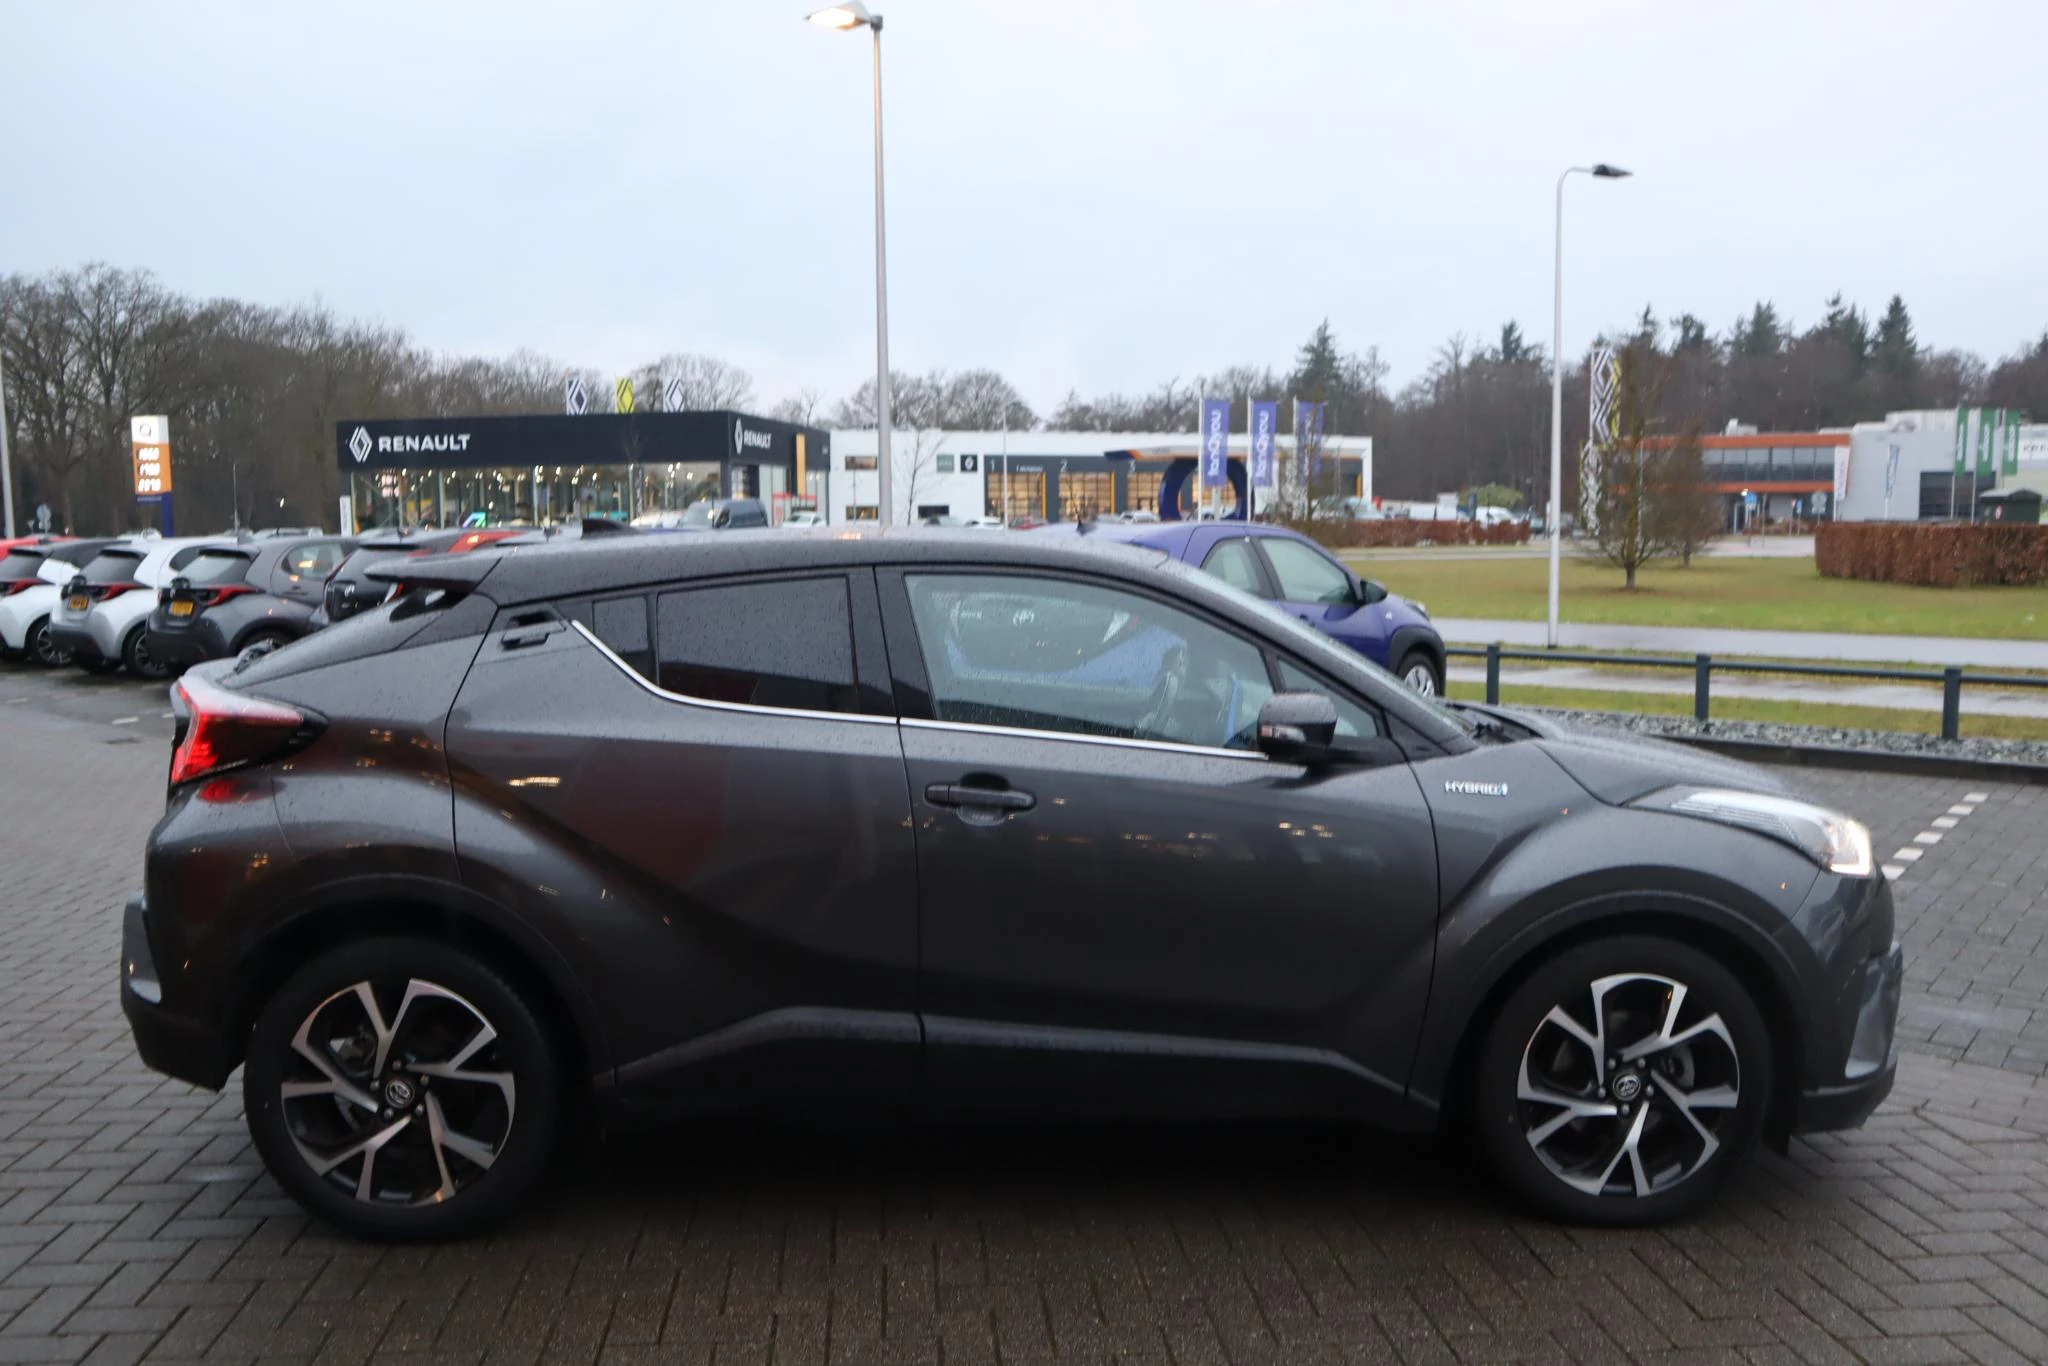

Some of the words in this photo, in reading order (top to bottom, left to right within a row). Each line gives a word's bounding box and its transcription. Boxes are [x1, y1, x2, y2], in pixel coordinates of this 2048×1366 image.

[378, 433, 471, 453] RENAULT
[743, 428, 772, 450] RENAULT
[1059, 458, 1069, 473] 2
[1444, 780, 1499, 796] HYBRID
